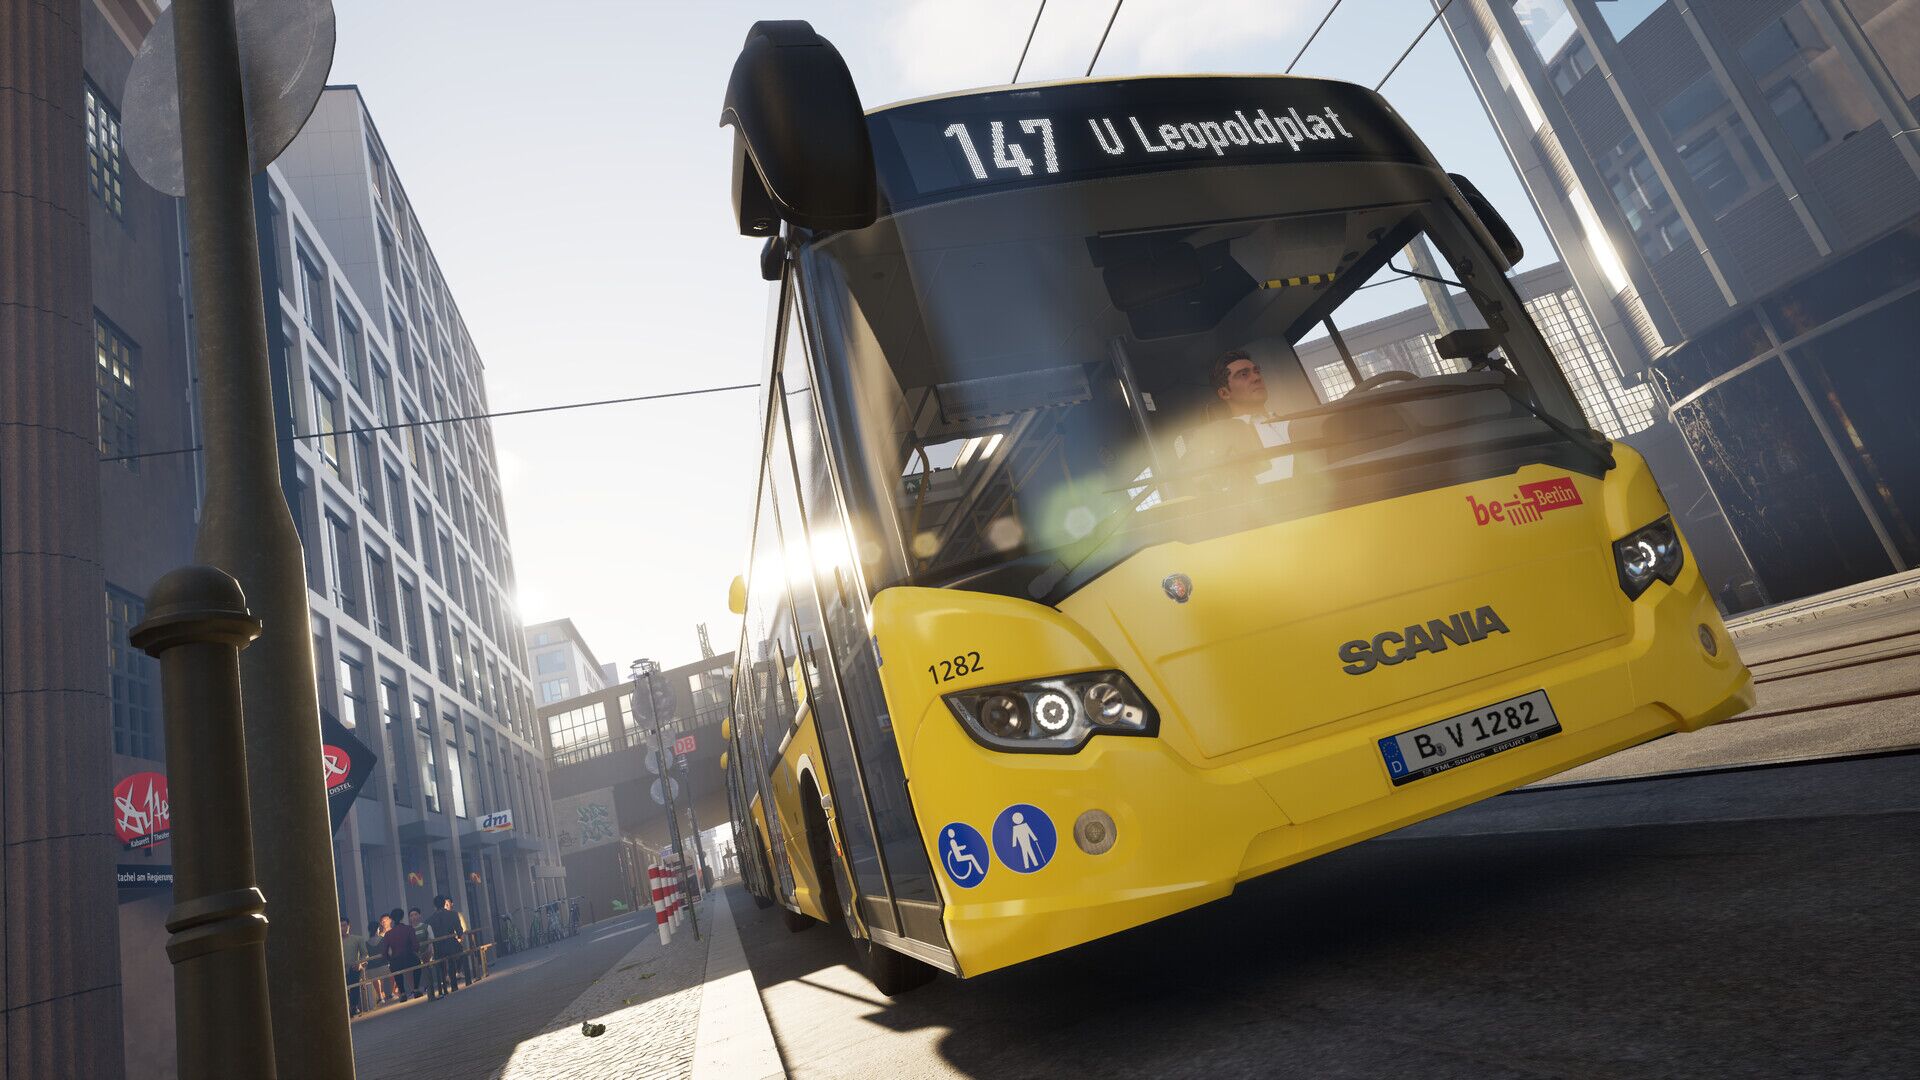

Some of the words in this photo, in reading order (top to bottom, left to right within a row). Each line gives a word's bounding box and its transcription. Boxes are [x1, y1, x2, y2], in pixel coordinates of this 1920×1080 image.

[944, 118, 1061, 179] 147
[1089, 118, 1124, 154] U
[1129, 105, 1353, 156] Leopoldplat
[1533, 485, 1576, 506] Berlin
[1466, 495, 1505, 526] be
[1338, 605, 1510, 675] SCANIA
[928, 651, 984, 684] 1282
[1414, 734, 1436, 758] B
[1445, 722, 1463, 747] V
[1471, 700, 1539, 741] 1282
[675, 736, 694, 754] DB
[1493, 738, 1526, 753] ERFURT
[1391, 760, 1402, 773] D
[329, 782, 352, 795] DISTEL
[482, 813, 508, 828] dm
[130, 837, 150, 848] Kabarett
[154, 831, 170, 842] Theater
[118, 872, 136, 881] tachel
[137, 874, 146, 882] am
[146, 872, 174, 884] Regierung
